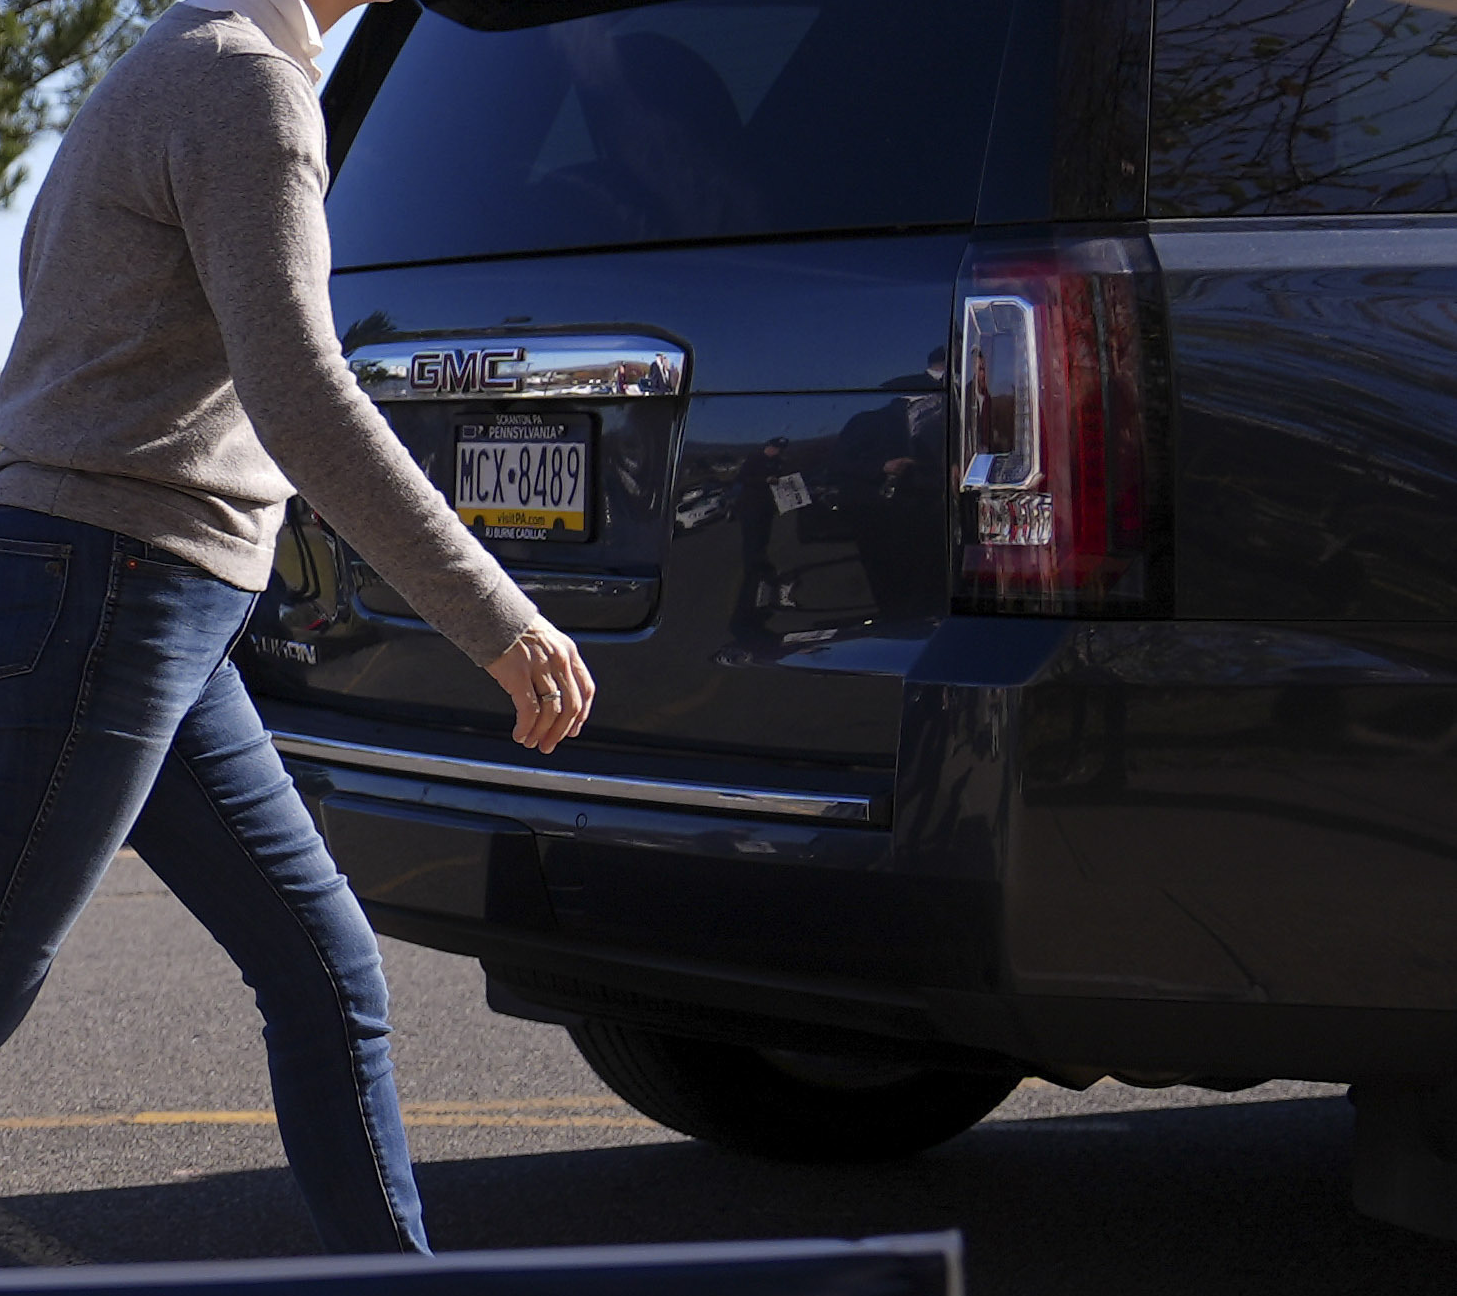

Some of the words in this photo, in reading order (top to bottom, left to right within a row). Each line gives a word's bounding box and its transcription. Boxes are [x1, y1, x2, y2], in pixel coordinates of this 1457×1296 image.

[410, 348, 527, 393] GMC
[489, 425, 557, 439] PENNSYLVANIA
[497, 512, 546, 525] visitPA.com
[250, 633, 318, 665] YUKON
